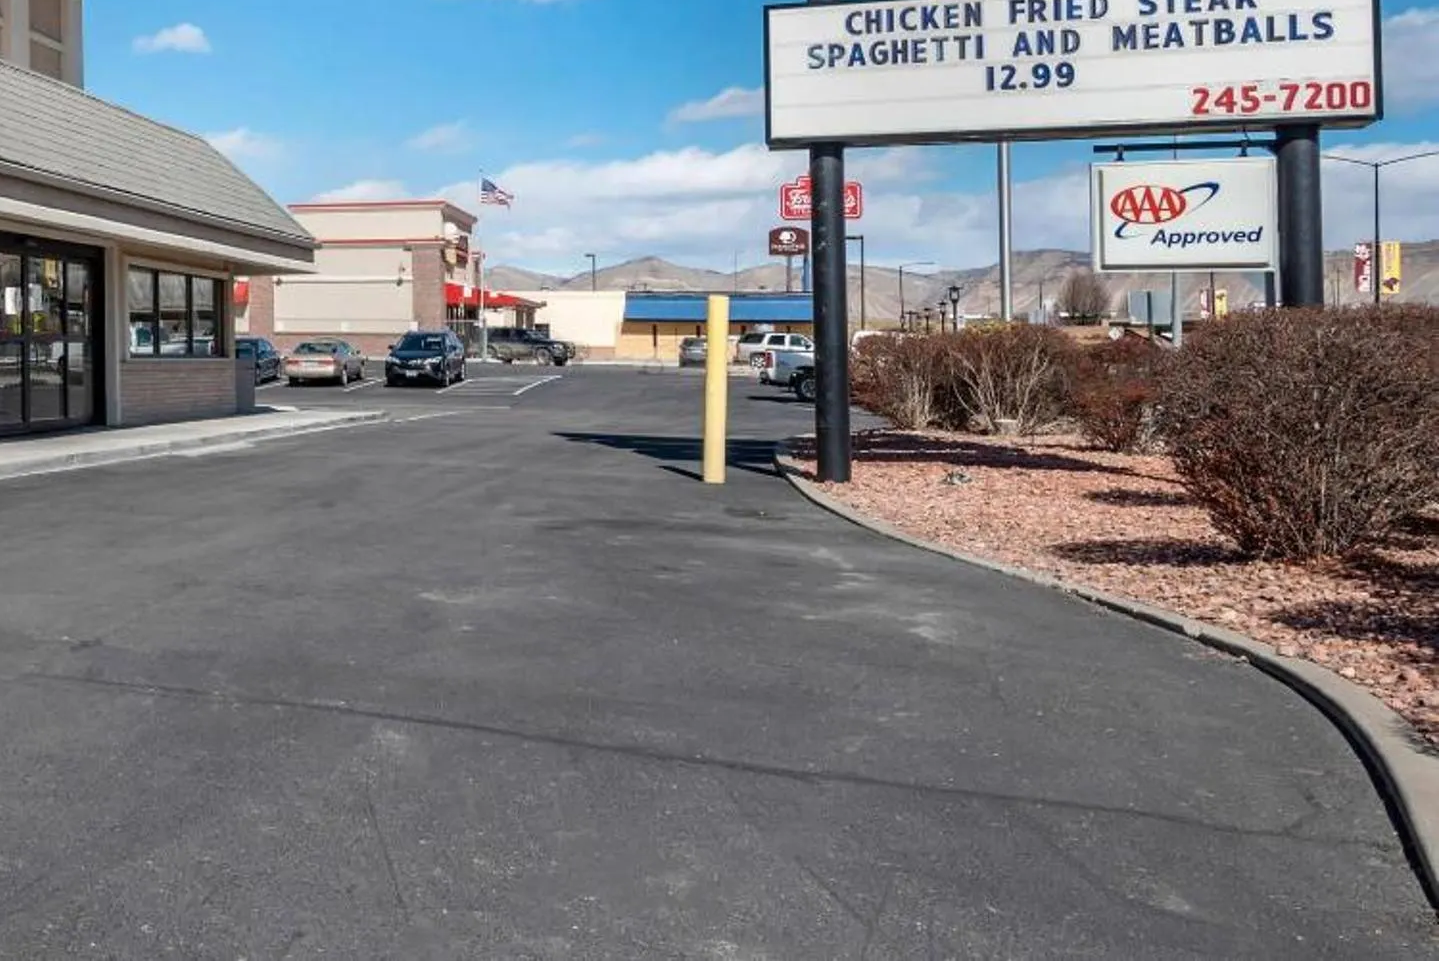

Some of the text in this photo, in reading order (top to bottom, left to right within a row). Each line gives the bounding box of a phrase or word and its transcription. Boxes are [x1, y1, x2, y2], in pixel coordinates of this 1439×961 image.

[845, 1, 983, 36] CHICKEN
[808, 12, 1334, 69] SPAGHETTI AND MEATBALLS
[985, 62, 1076, 91] 12.99
[1192, 81, 1372, 115] 245-7200
[1114, 186, 1183, 223] AAA
[1150, 226, 1263, 248] Approved
